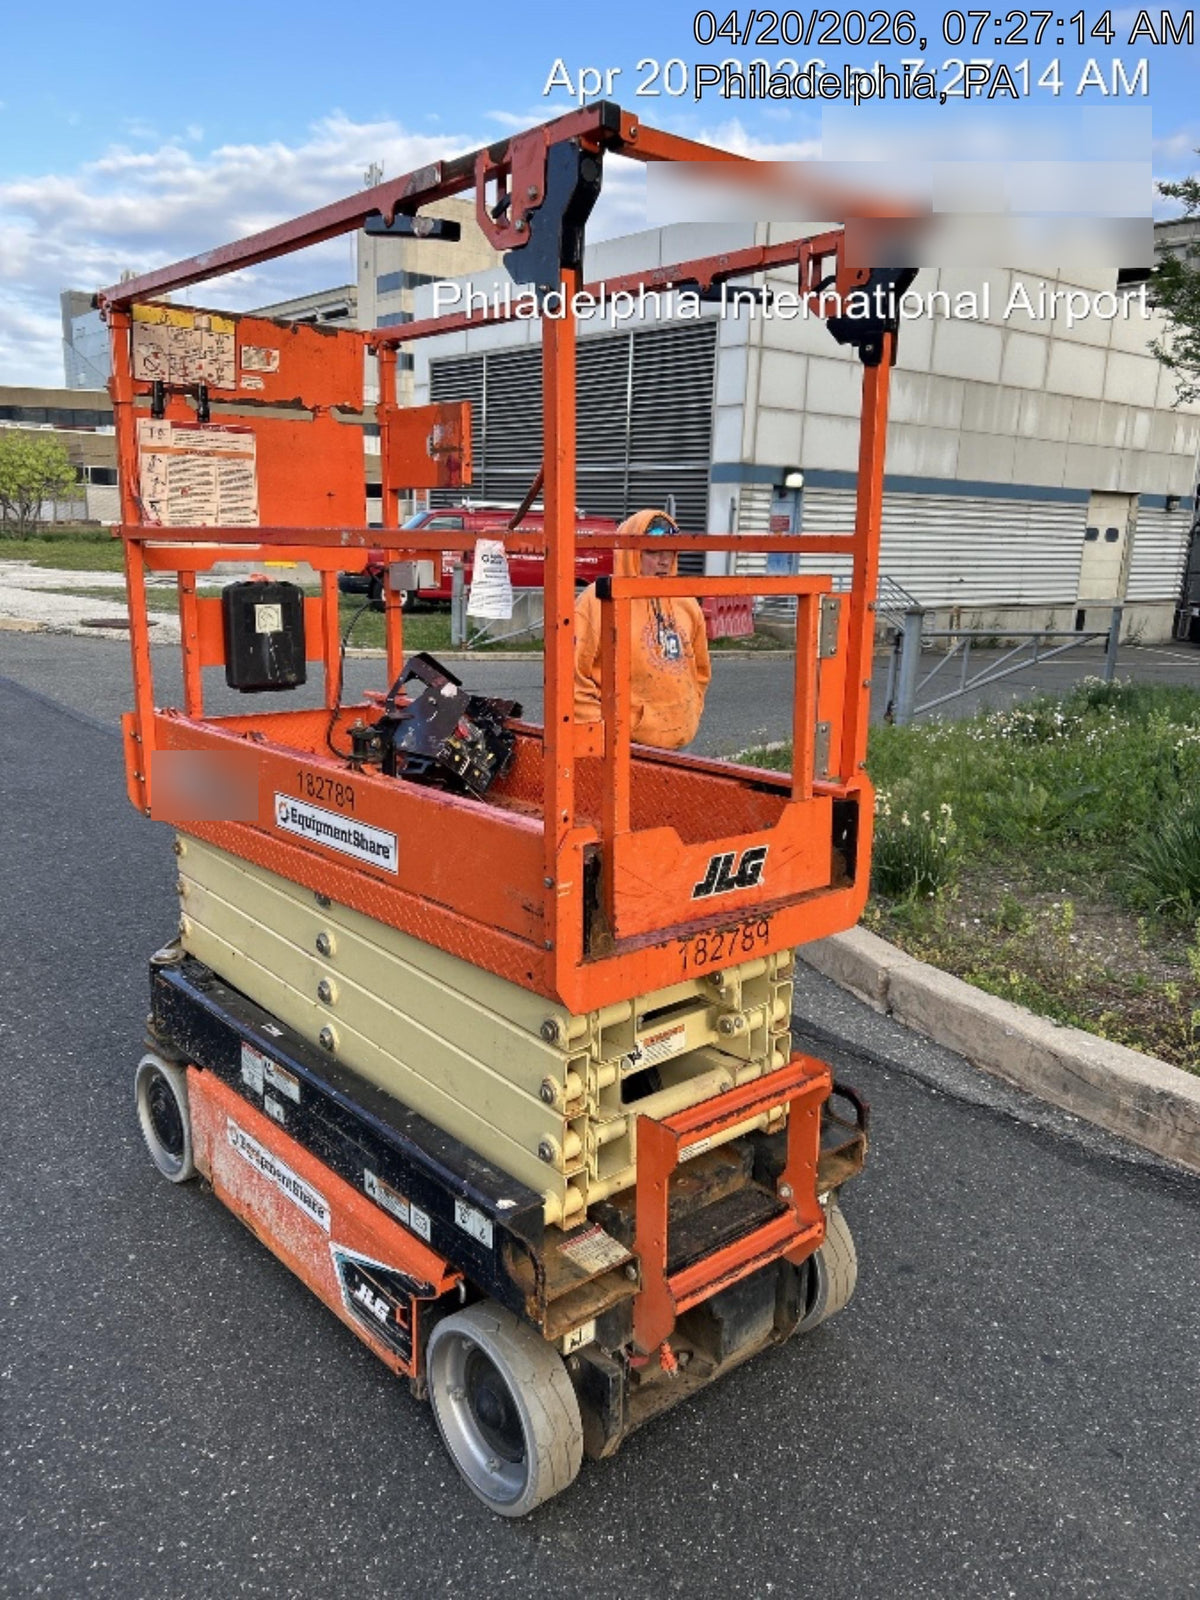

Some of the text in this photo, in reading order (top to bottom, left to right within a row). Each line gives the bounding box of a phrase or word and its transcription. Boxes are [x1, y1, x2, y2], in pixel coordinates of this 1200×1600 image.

[296, 770, 355, 811] 182789
[290, 806, 391, 859] EquipmentShare
[690, 844, 769, 901] JLG
[679, 919, 771, 971] 182789
